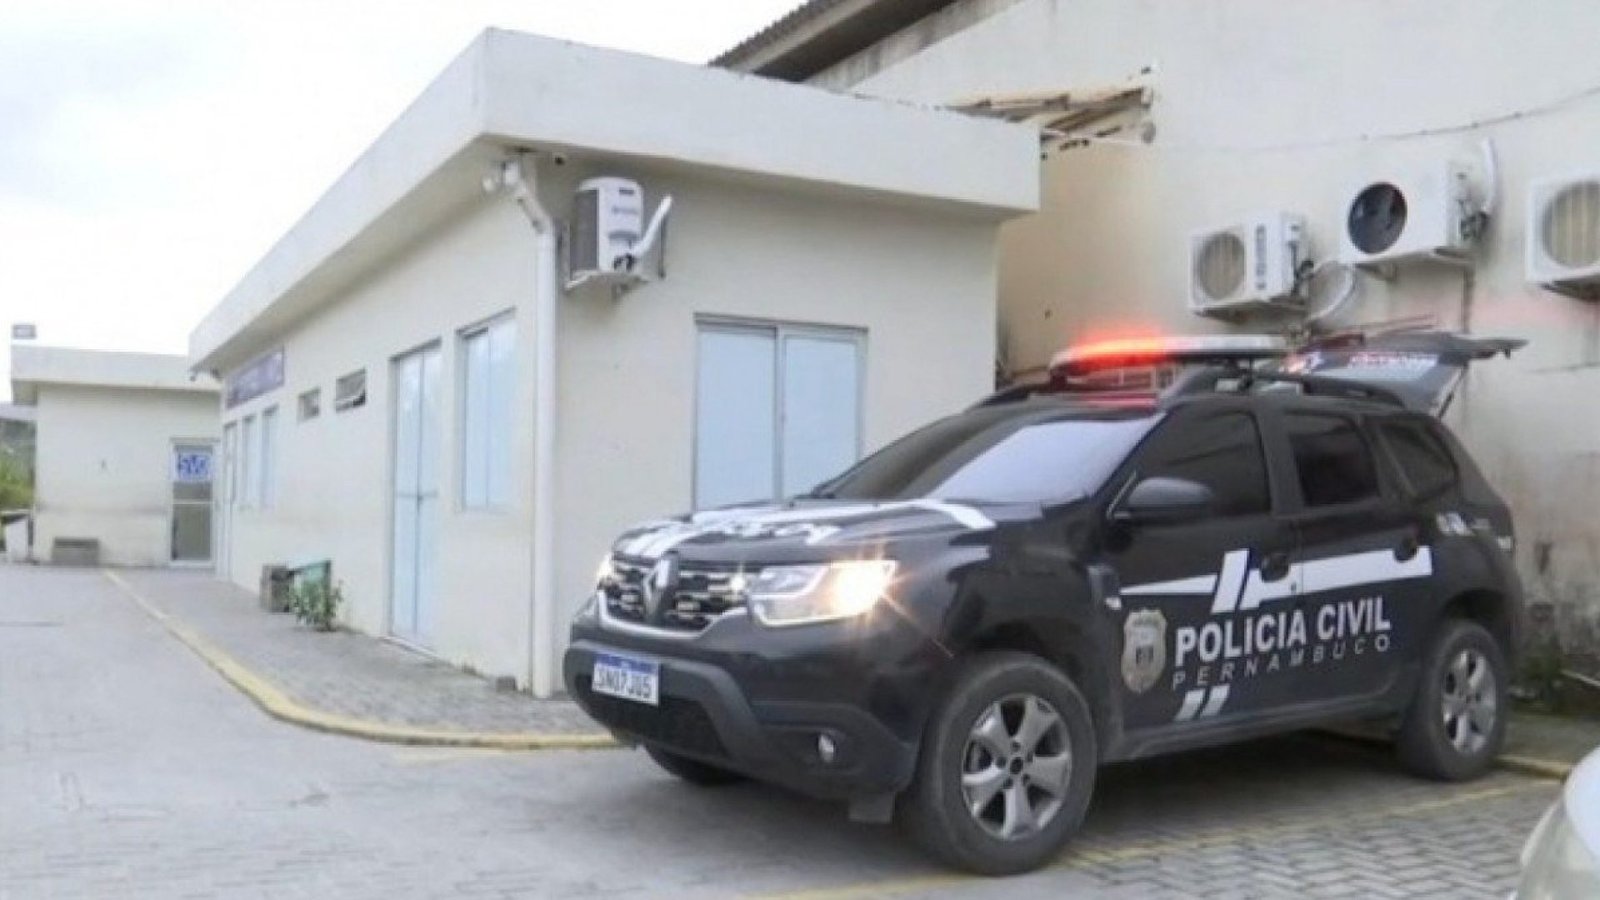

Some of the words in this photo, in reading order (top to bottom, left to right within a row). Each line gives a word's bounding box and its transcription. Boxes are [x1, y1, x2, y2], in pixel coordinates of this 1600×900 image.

[1172, 633, 1391, 690] PERNAMBUCO
[1174, 608, 1307, 667] POLICIA
[1316, 595, 1391, 640] CIVIL
